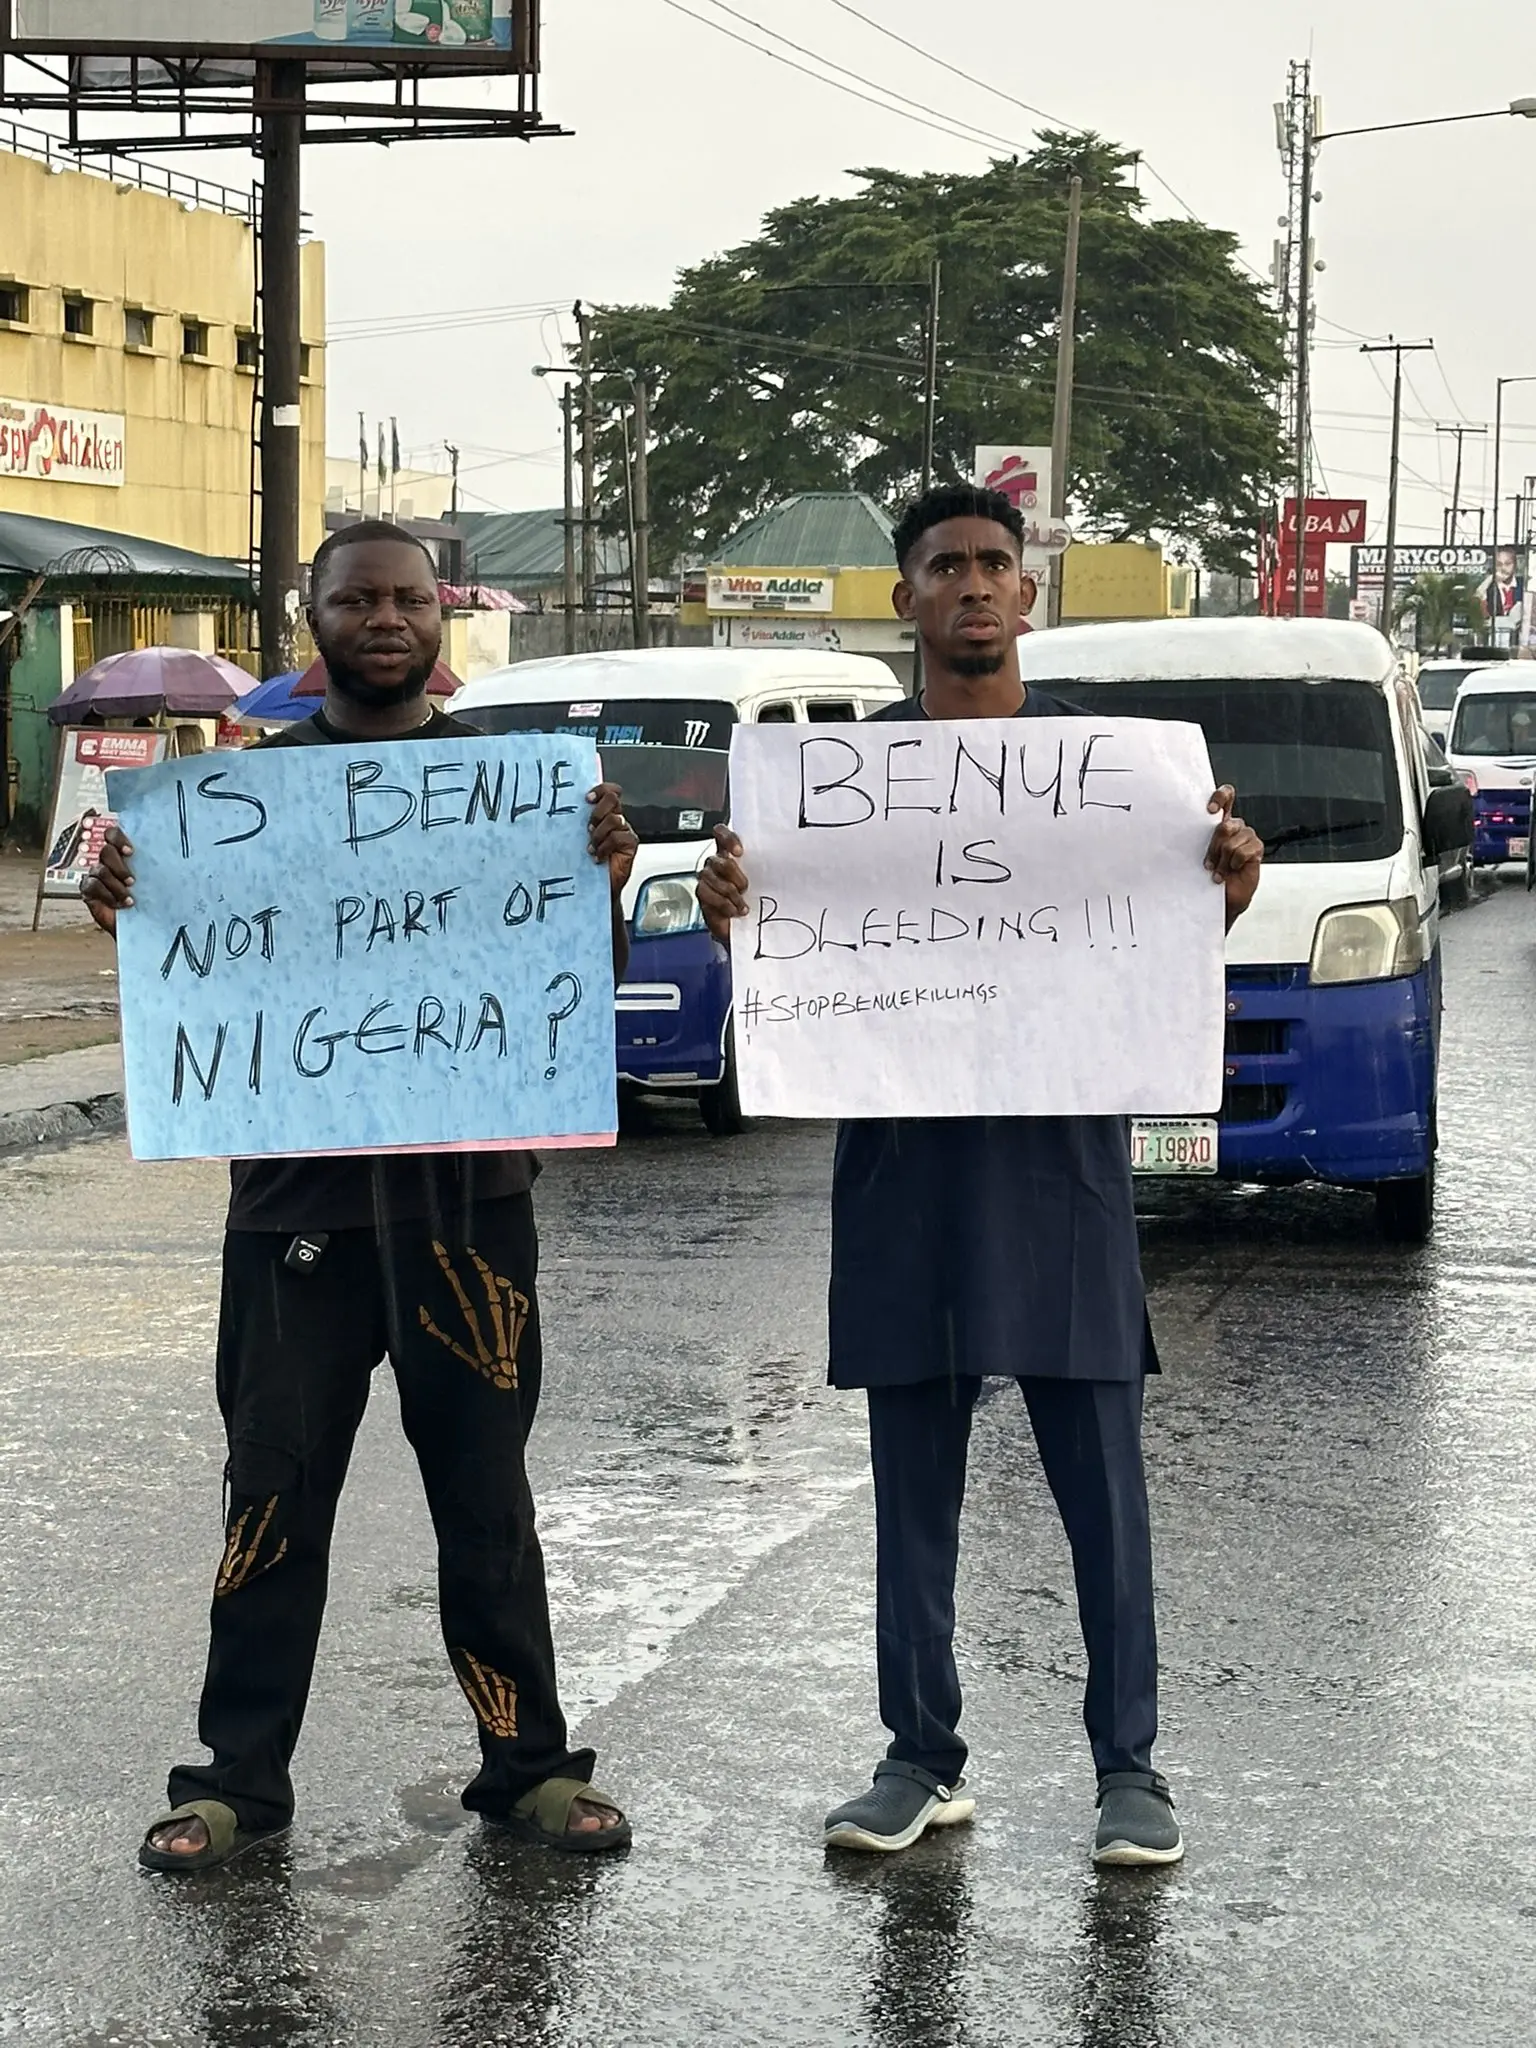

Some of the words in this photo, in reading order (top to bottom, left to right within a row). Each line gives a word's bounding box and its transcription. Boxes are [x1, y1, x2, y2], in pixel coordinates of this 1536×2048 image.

[728, 578, 763, 592] Vita
[766, 578, 823, 593] Addict
[101, 737, 147, 750] EMMA
[176, 771, 268, 858] IS
[343, 759, 578, 856] BENUE
[798, 734, 1133, 828] BENUE
[935, 839, 1012, 887] IS
[160, 906, 282, 980] NOT
[335, 886, 461, 959] PART
[503, 877, 574, 926] OF
